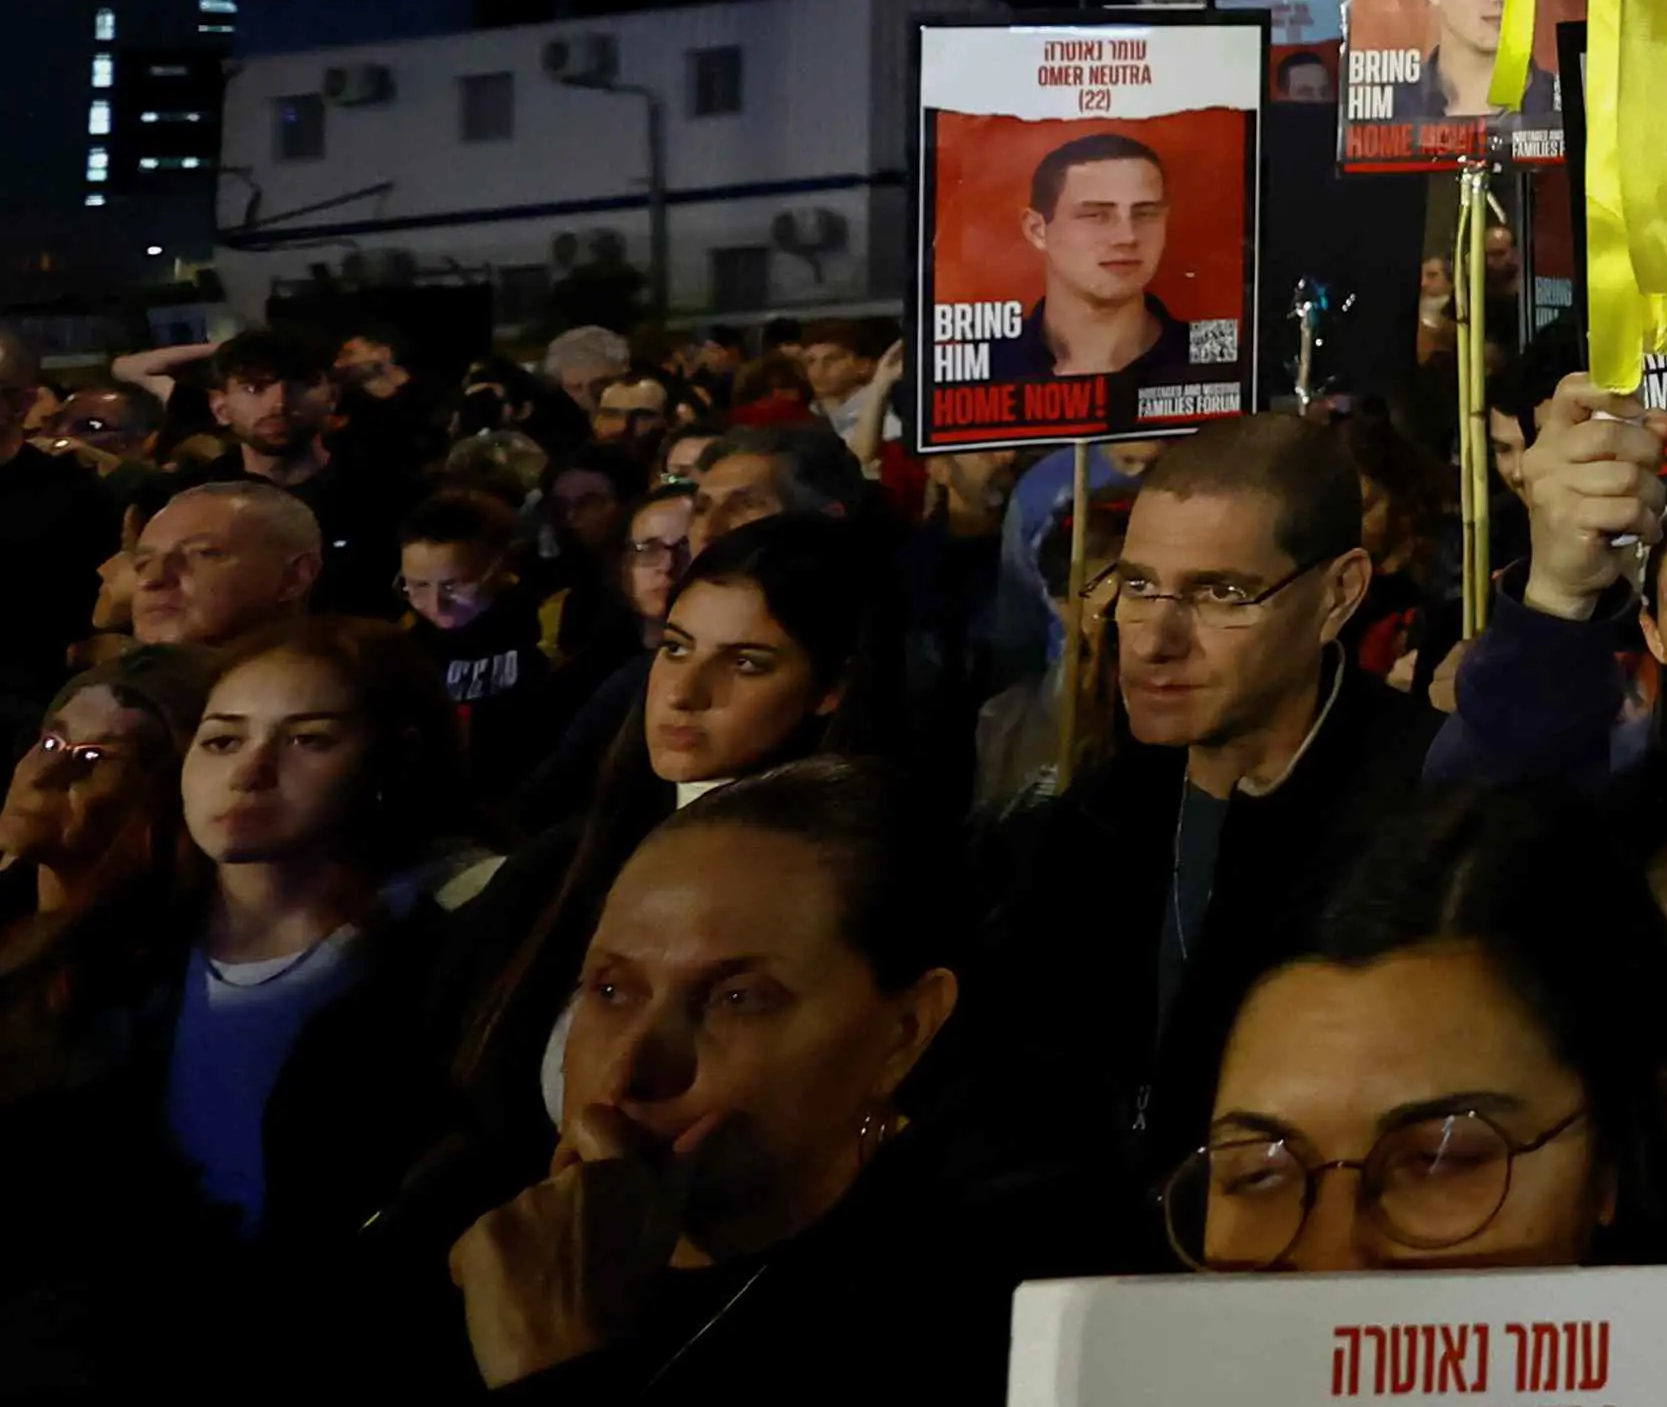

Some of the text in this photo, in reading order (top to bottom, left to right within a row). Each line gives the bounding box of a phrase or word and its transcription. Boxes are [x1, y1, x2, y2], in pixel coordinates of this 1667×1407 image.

[1044, 40, 1147, 62] עומר נאוטרה
[1349, 48, 1421, 84] BRING
[1038, 64, 1152, 86] OMER NEUTRA
[1079, 89, 1111, 112] (22)
[1348, 85, 1393, 120] HIM
[1346, 124, 1413, 159] HOME
[1512, 140, 1558, 160] FAMILIES
[934, 301, 1023, 342] BRING
[934, 343, 990, 382] HIM
[933, 382, 1015, 426] HOME
[1024, 376, 1107, 422] NOW!
[1138, 393, 1241, 418] FAMILIES FORUM
[1331, 1320, 1610, 1396] עומר נאוטרה
